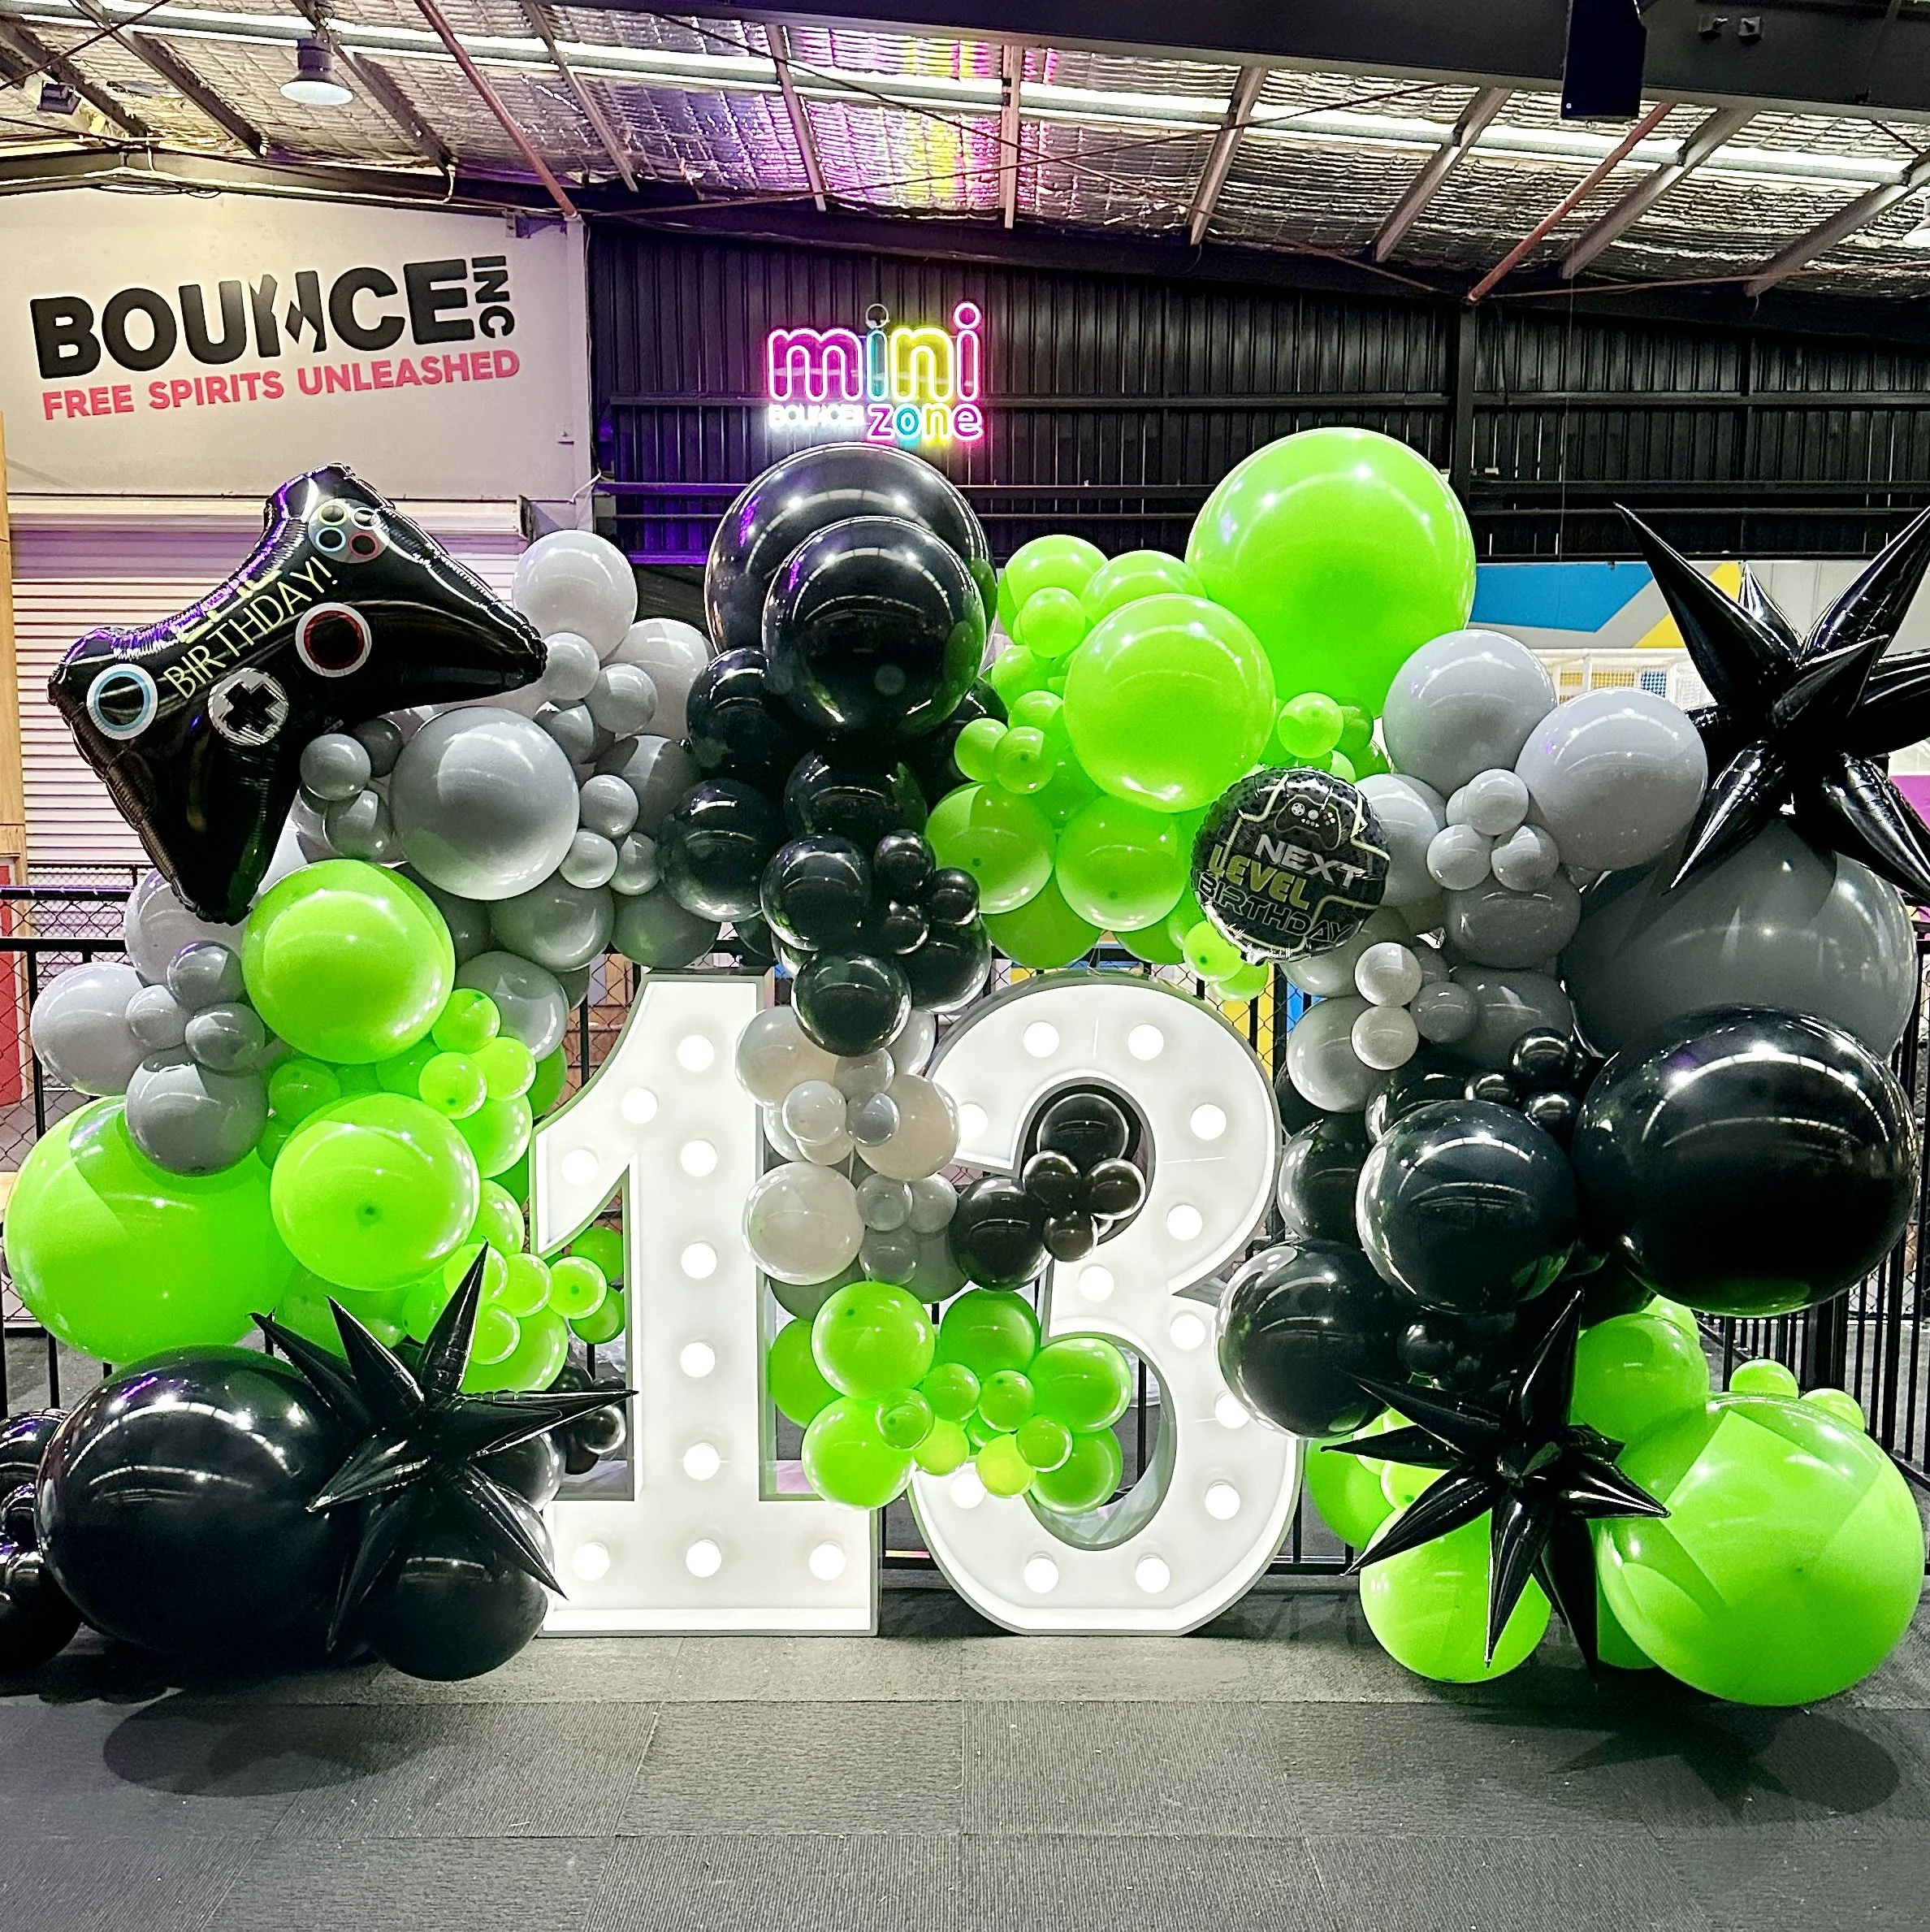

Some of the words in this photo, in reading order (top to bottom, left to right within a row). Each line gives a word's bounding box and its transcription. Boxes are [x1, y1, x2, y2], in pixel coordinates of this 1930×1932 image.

[30, 258, 475, 379] BOUNCE
[471, 255, 516, 339] INC
[42, 385, 135, 421] FREE
[149, 370, 284, 410] SPIRITS
[298, 349, 521, 396] UNLEASHED
[768, 301, 981, 402] mini
[867, 403, 984, 441] zone
[162, 556, 339, 700] BIRTHDAY!
[1208, 843, 1310, 911] LEVEL
[1253, 834, 1368, 890] NEXT
[1198, 871, 1355, 943] BIRTHDAY
[532, 972, 1300, 1636] 13
